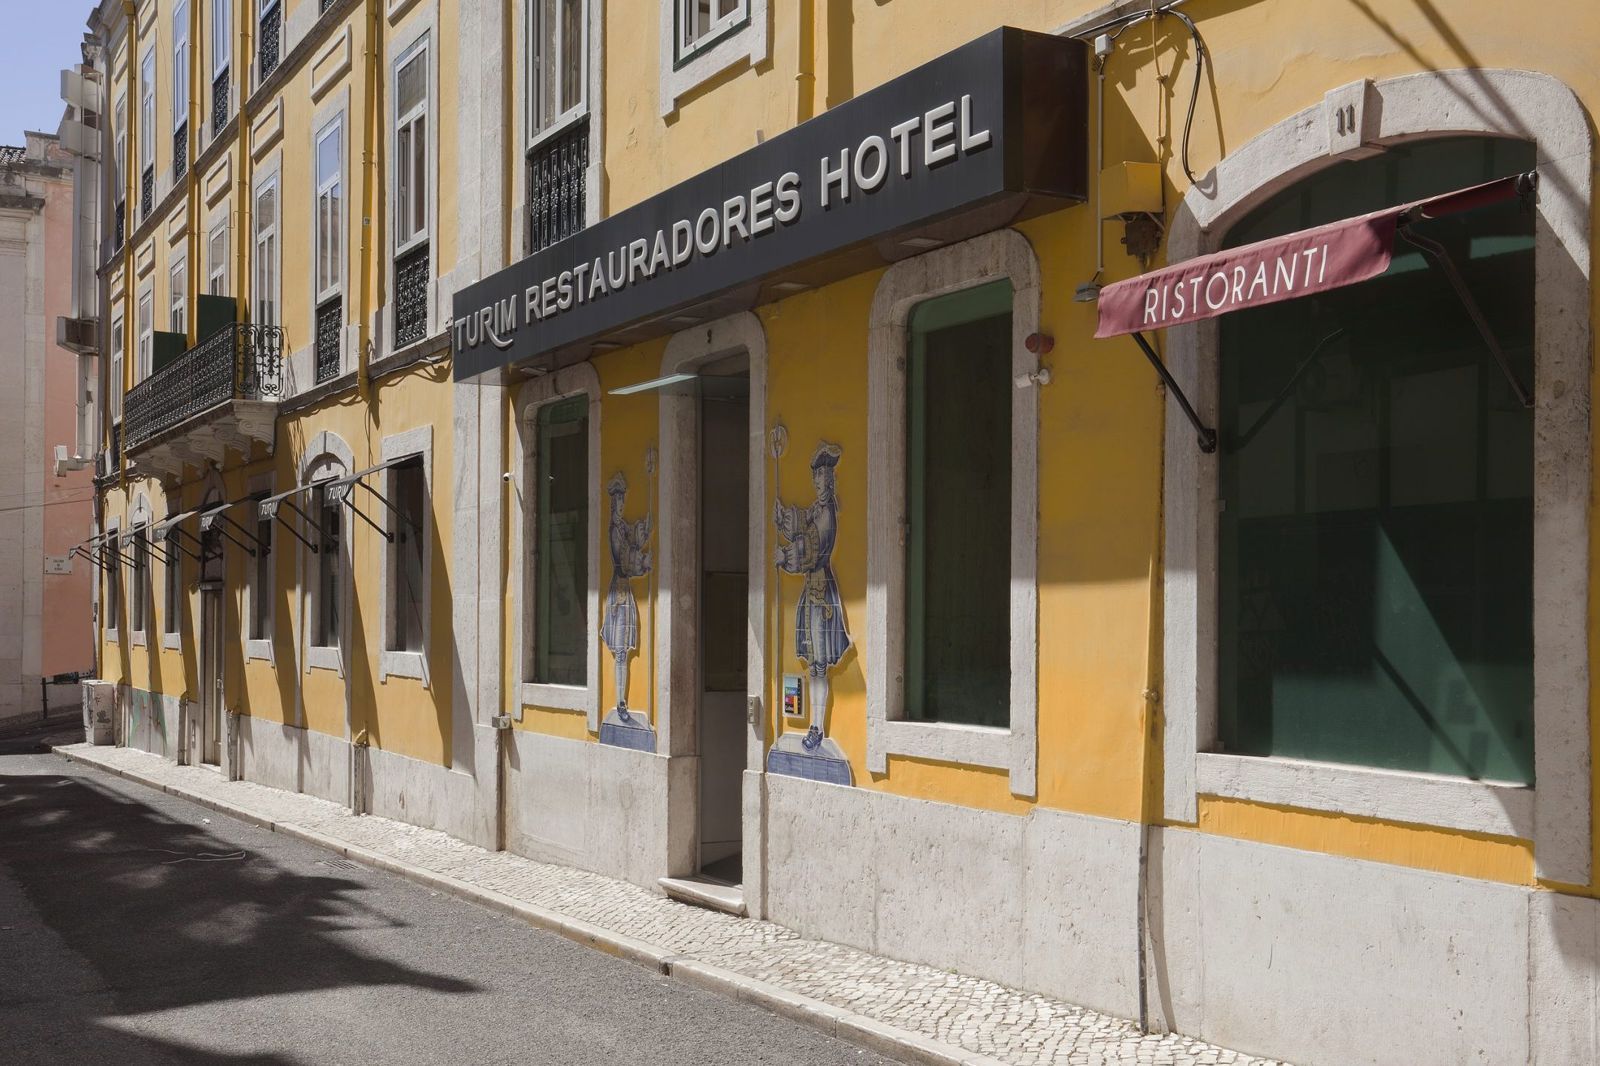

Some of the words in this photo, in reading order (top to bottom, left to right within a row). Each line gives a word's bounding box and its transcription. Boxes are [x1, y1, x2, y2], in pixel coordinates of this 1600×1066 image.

[455, 294, 518, 350] TURIM
[525, 172, 801, 324] RESTAURADORES
[820, 94, 990, 207] HOTEL
[1144, 244, 1328, 324] RISTORANTI
